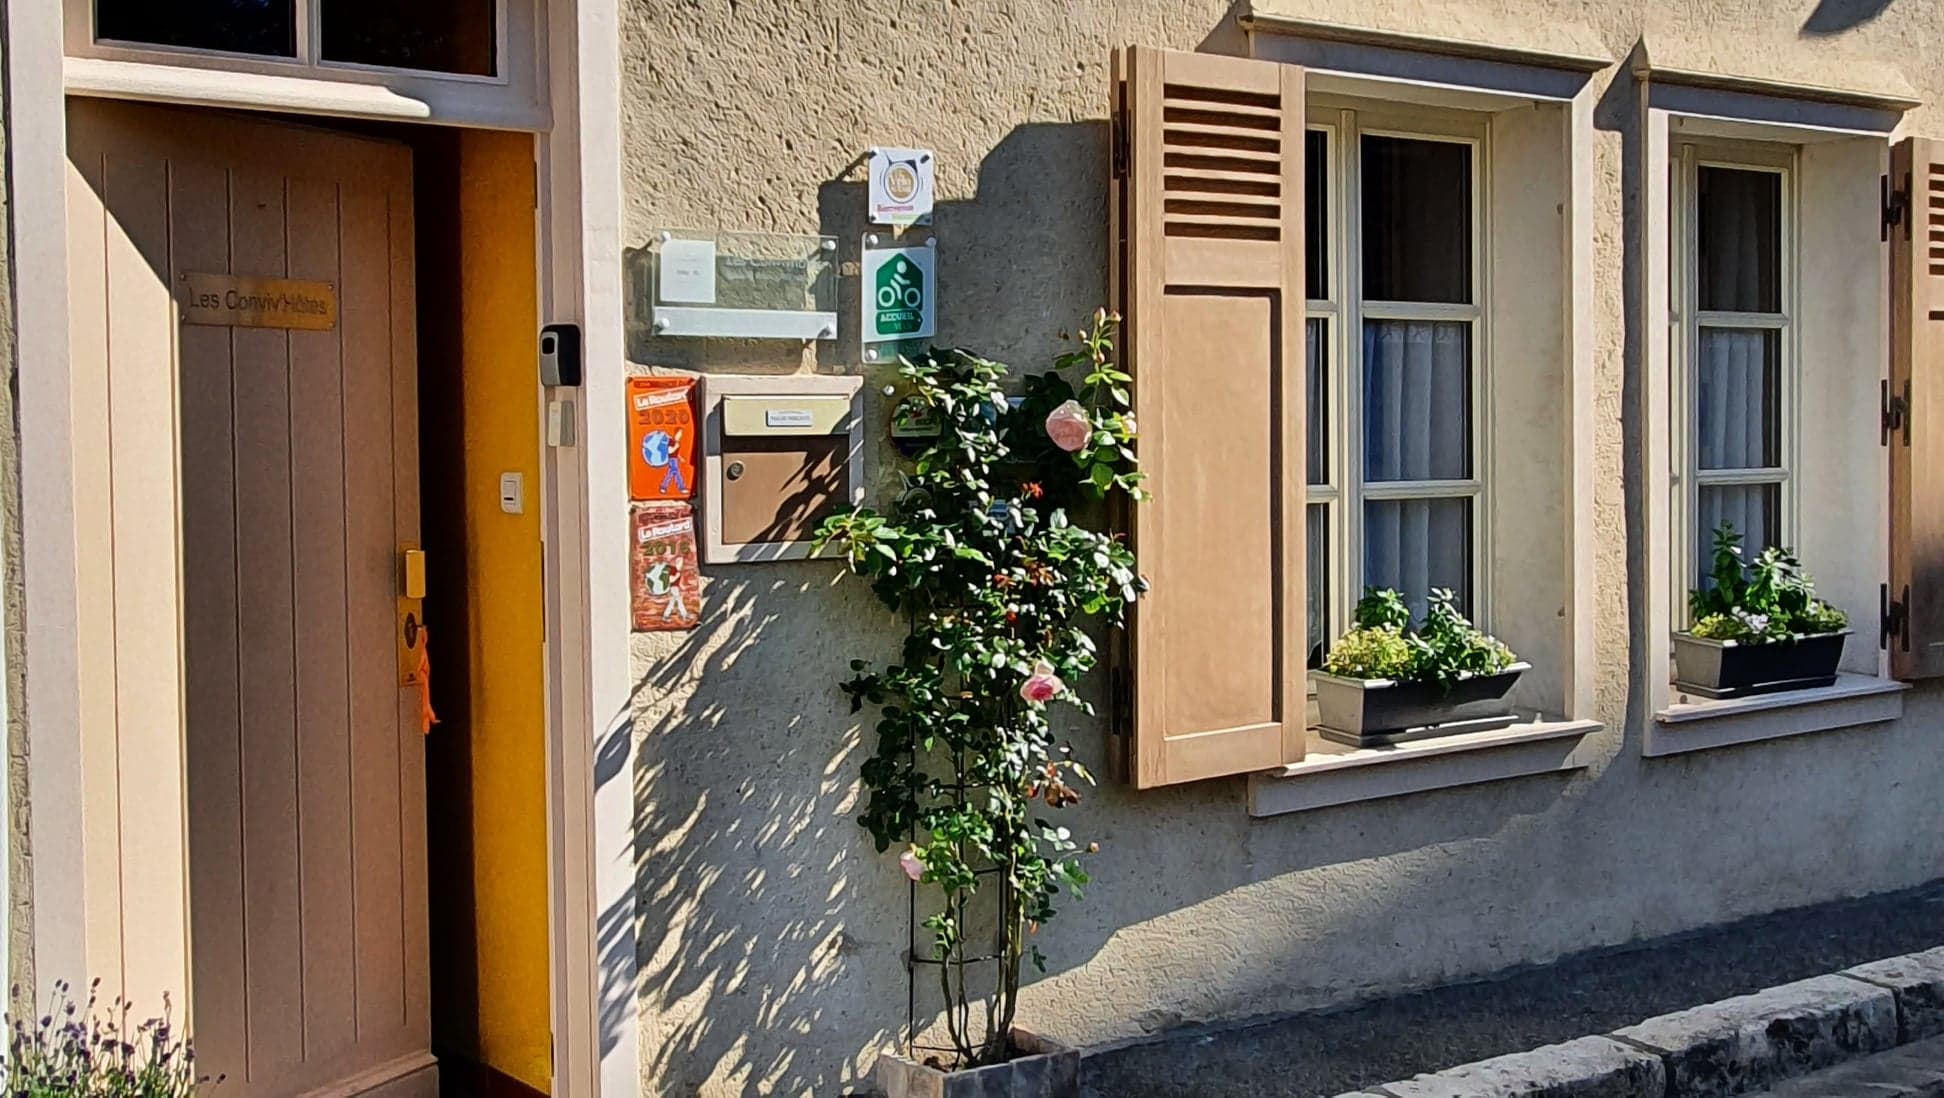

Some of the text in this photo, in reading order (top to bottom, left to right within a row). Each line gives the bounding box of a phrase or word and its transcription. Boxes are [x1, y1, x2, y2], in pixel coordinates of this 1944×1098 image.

[188, 287, 220, 309] Les
[880, 312, 915, 322] ACCUEIL
[639, 409, 690, 425] 2020
[643, 542, 691, 556] 2016
